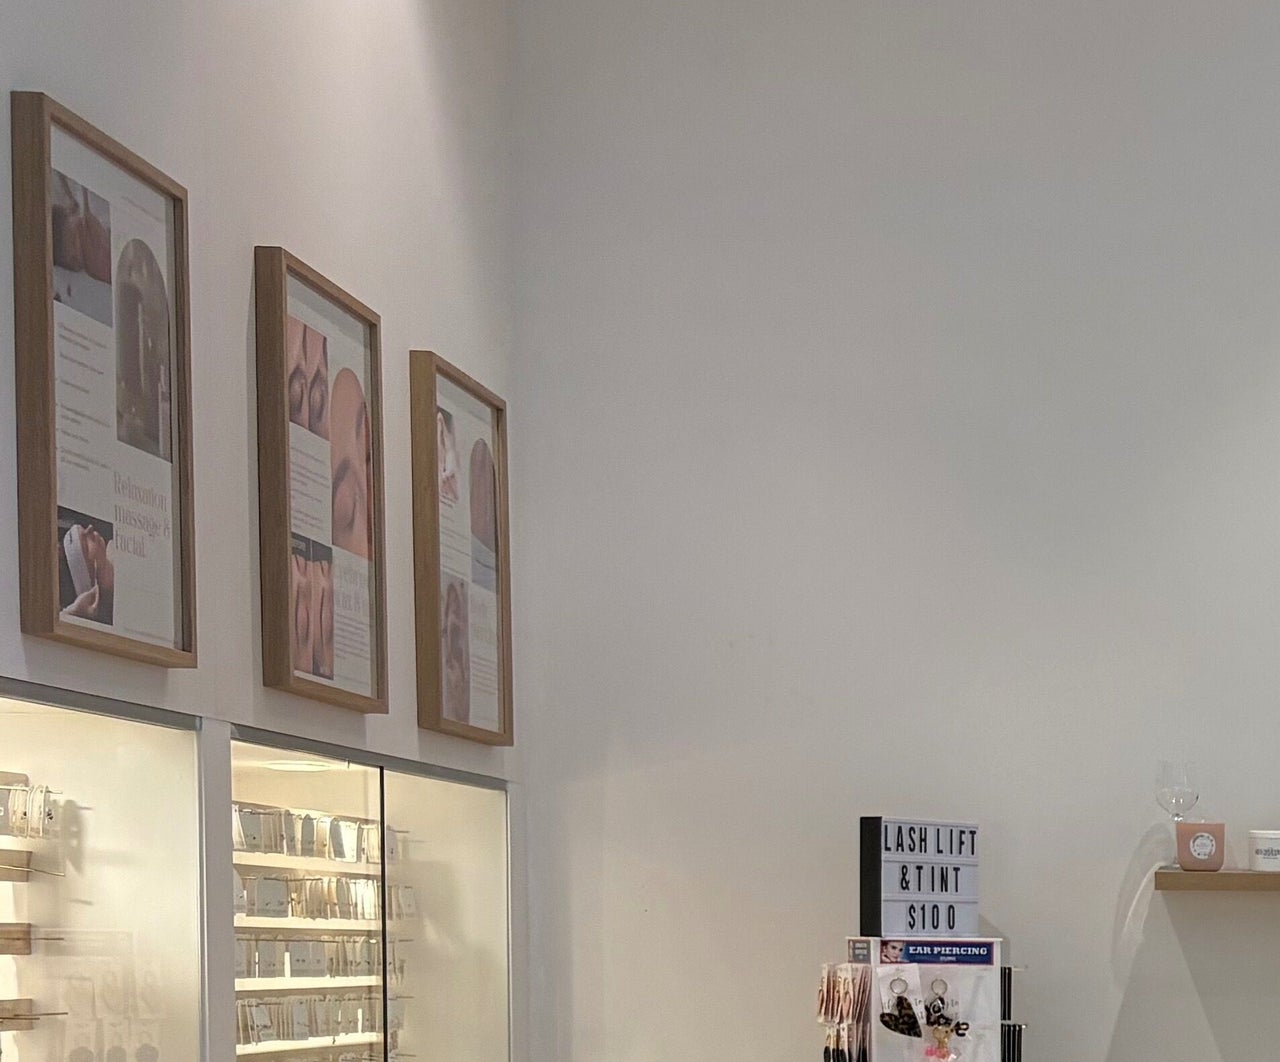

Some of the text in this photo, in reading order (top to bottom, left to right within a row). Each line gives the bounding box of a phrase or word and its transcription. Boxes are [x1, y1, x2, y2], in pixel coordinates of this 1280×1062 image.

[884, 824, 977, 856] LASH LIFT
[900, 865, 961, 893] & TINT
[908, 903, 956, 931] $100
[909, 946, 988, 956] EAR PIERCING
